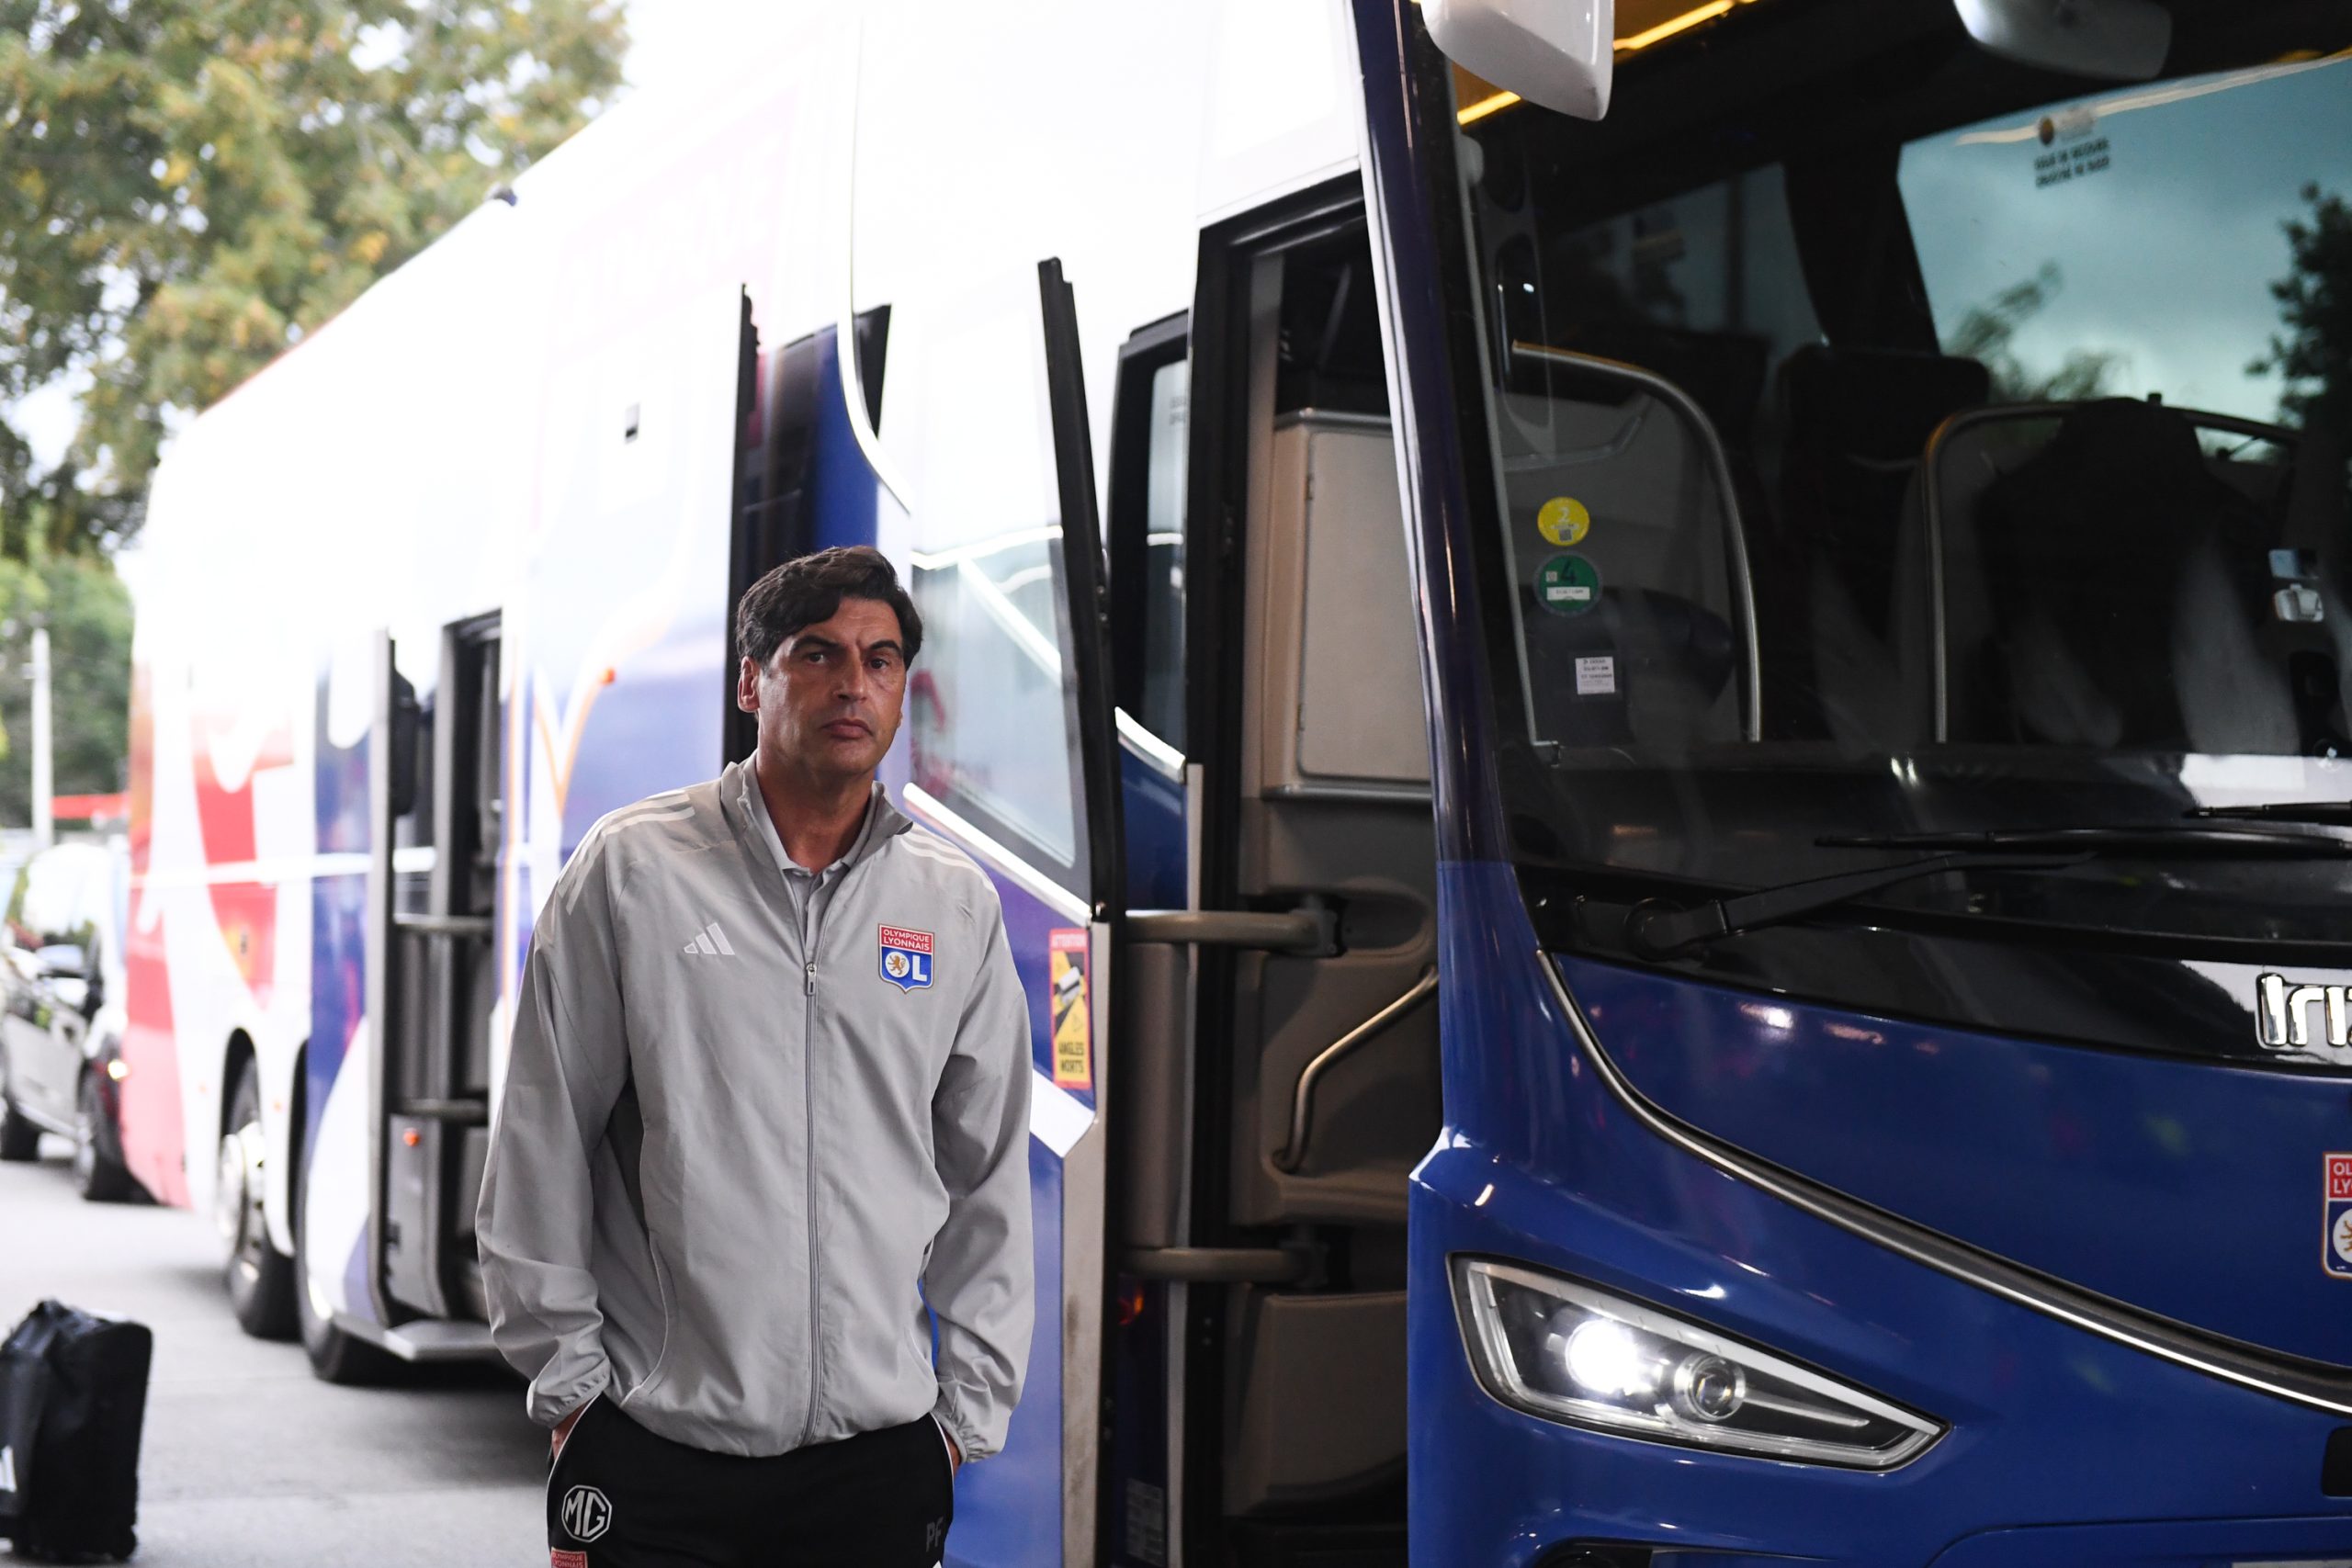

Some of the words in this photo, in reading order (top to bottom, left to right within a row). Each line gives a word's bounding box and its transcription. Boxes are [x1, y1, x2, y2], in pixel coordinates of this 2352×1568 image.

[1558, 506, 1570, 523] 2
[1560, 558, 1577, 585] 4
[883, 929, 930, 942] OLYMPIQUE
[883, 936, 930, 951] LYONNAIS
[1058, 1041, 1084, 1055] ANGLES
[1060, 1059, 1084, 1073] MORTS
[2334, 1179, 2352, 1194] LY
[564, 1489, 606, 1538] MG
